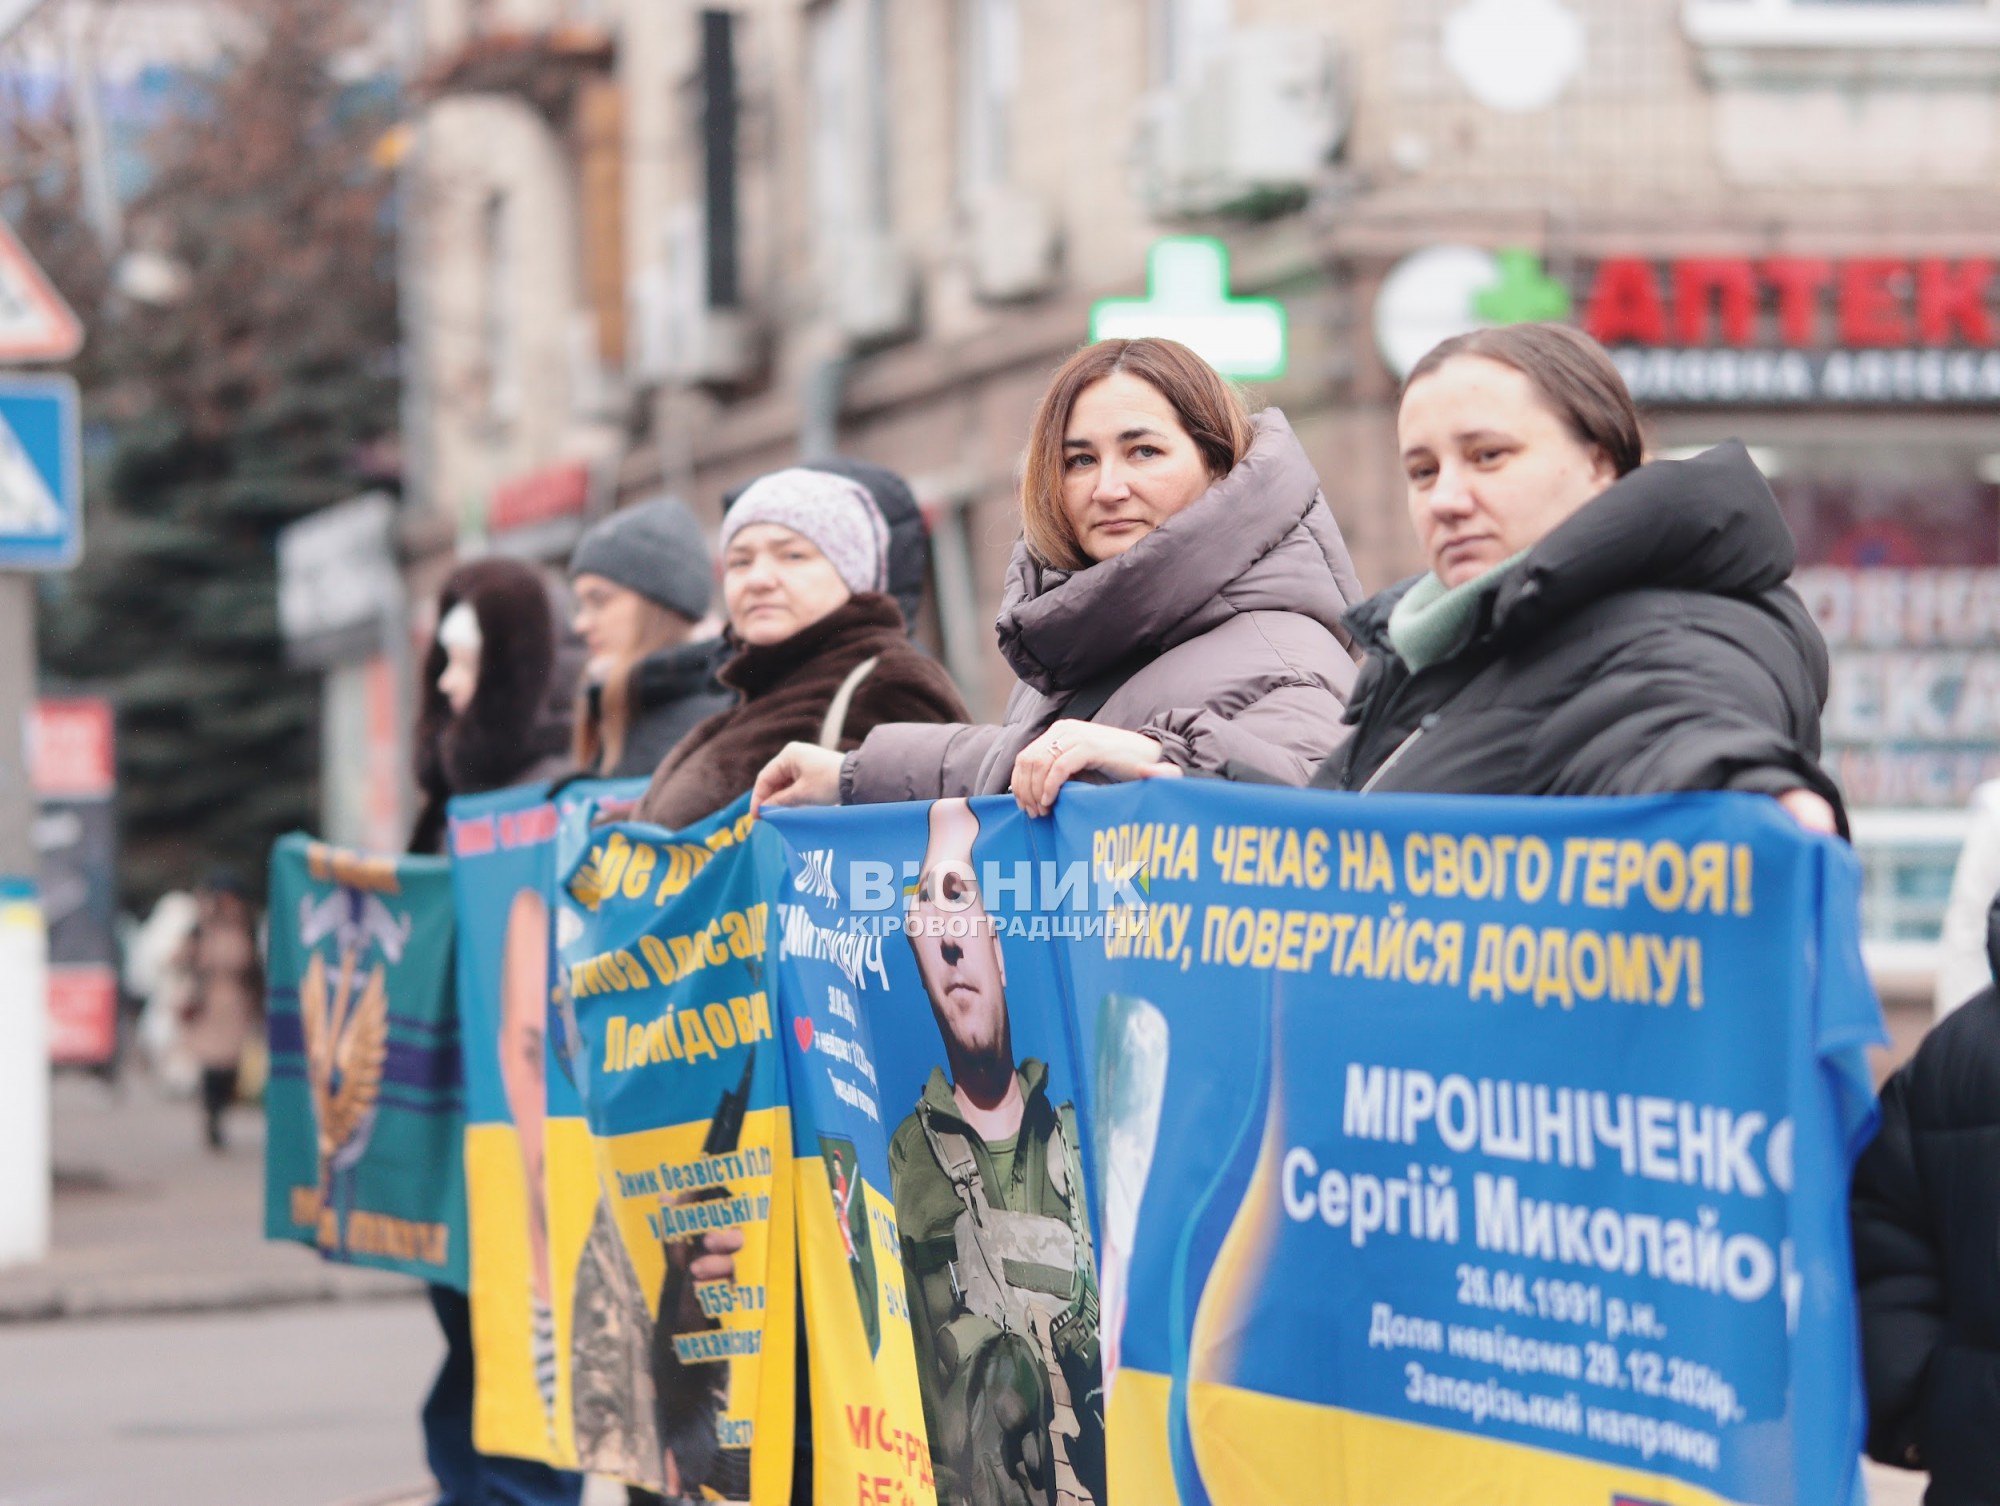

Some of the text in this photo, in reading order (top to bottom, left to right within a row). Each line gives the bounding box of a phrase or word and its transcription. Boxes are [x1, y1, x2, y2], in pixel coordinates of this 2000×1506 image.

[1093, 822, 1754, 917] РОДИНА ЧЕКАЄ НА СВОГО ГЕРОЯ!
[1200, 903, 1462, 987] ПОВЕРТАЙСЯ
[1469, 921, 1706, 1010] ДОДОМУ!
[1281, 1145, 1459, 1249] Сергій
[1367, 1300, 1444, 1352] Доля
[1447, 1322, 1583, 1381] невідома
[1403, 1359, 1584, 1437] Запорізький
